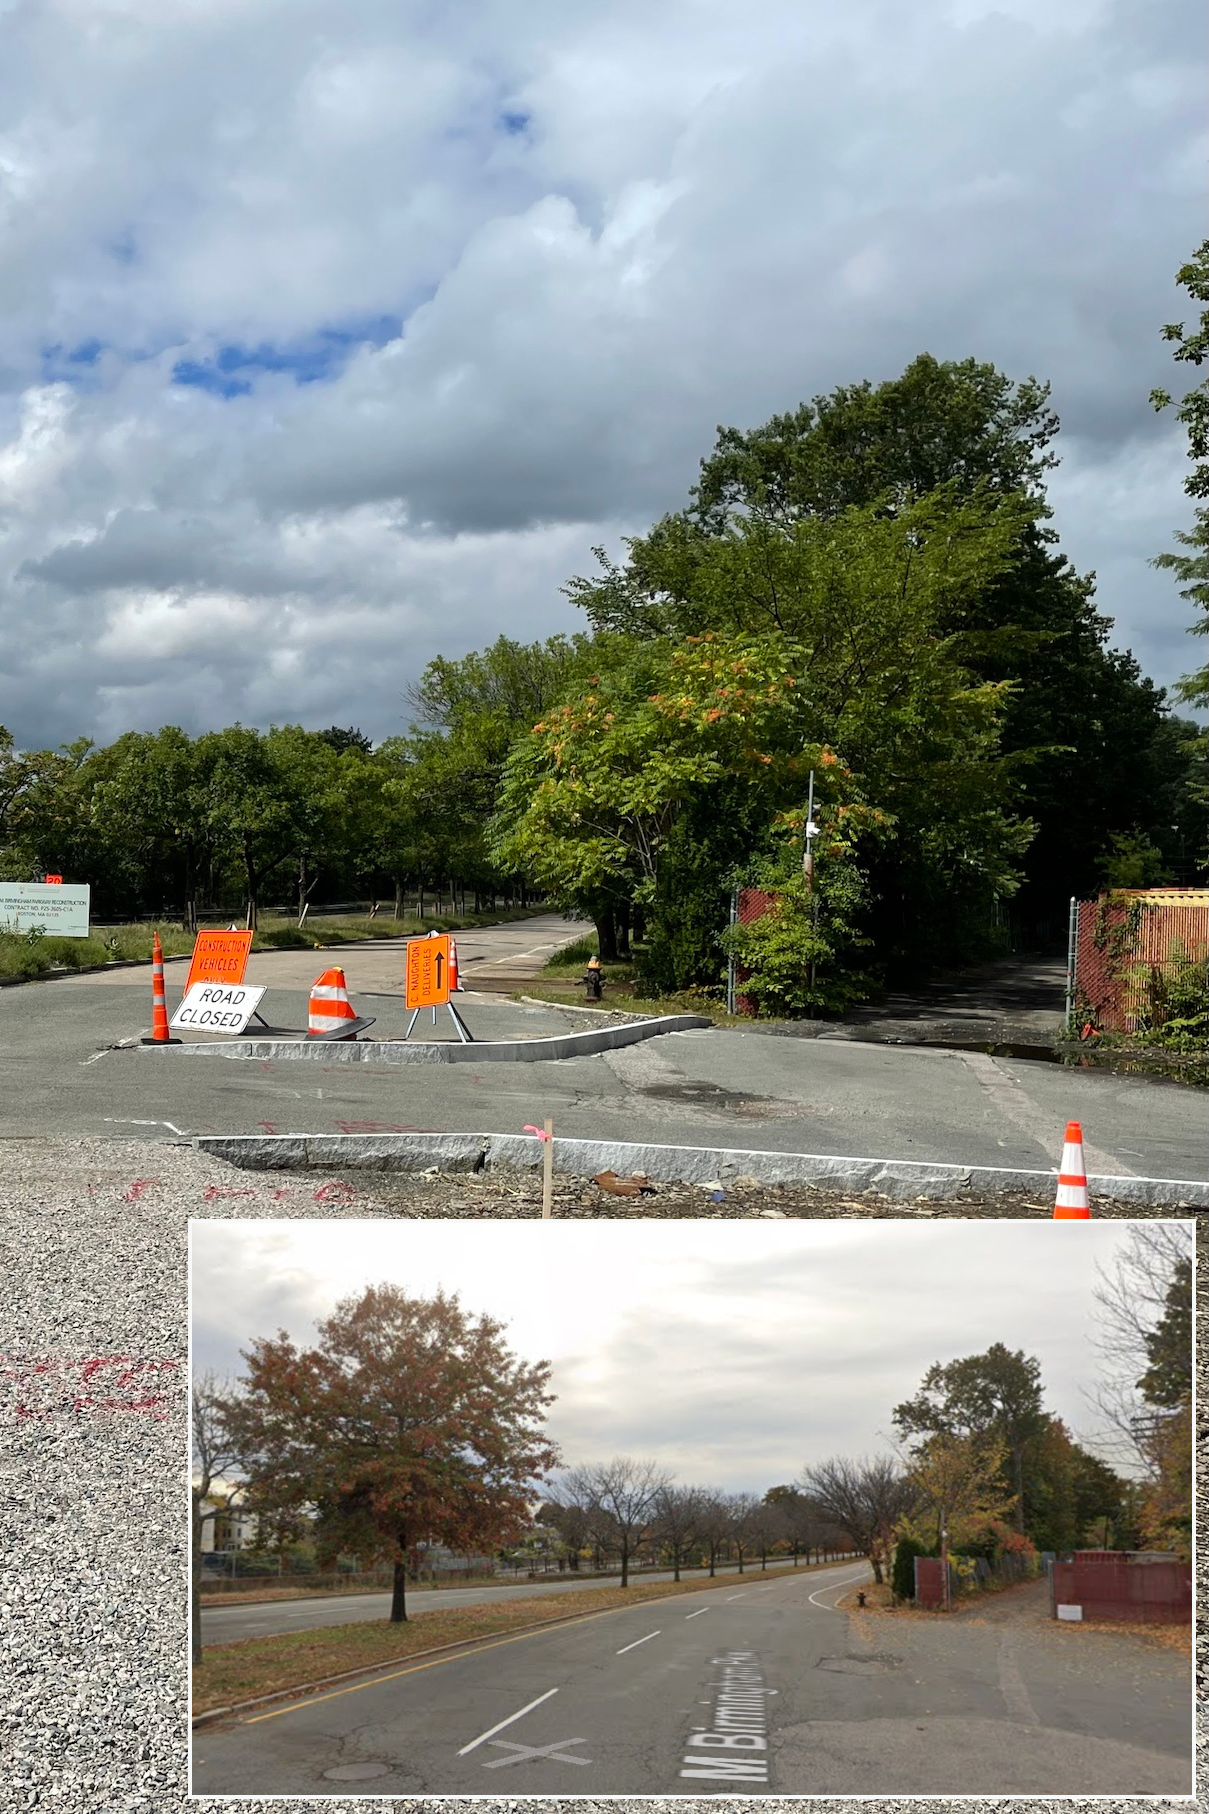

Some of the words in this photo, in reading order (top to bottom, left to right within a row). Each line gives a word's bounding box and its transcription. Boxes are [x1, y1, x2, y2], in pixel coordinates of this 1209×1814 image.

[198, 939, 246, 952] CONSTRUCTION
[199, 957, 239, 971] VEHICLES
[410, 946, 420, 991] NAUGHTON
[422, 948, 431, 996] DELIVERIES
[199, 988, 246, 1005] ROAD
[410, 994, 419, 1002] C.
[179, 1008, 243, 1027] CLOSED
